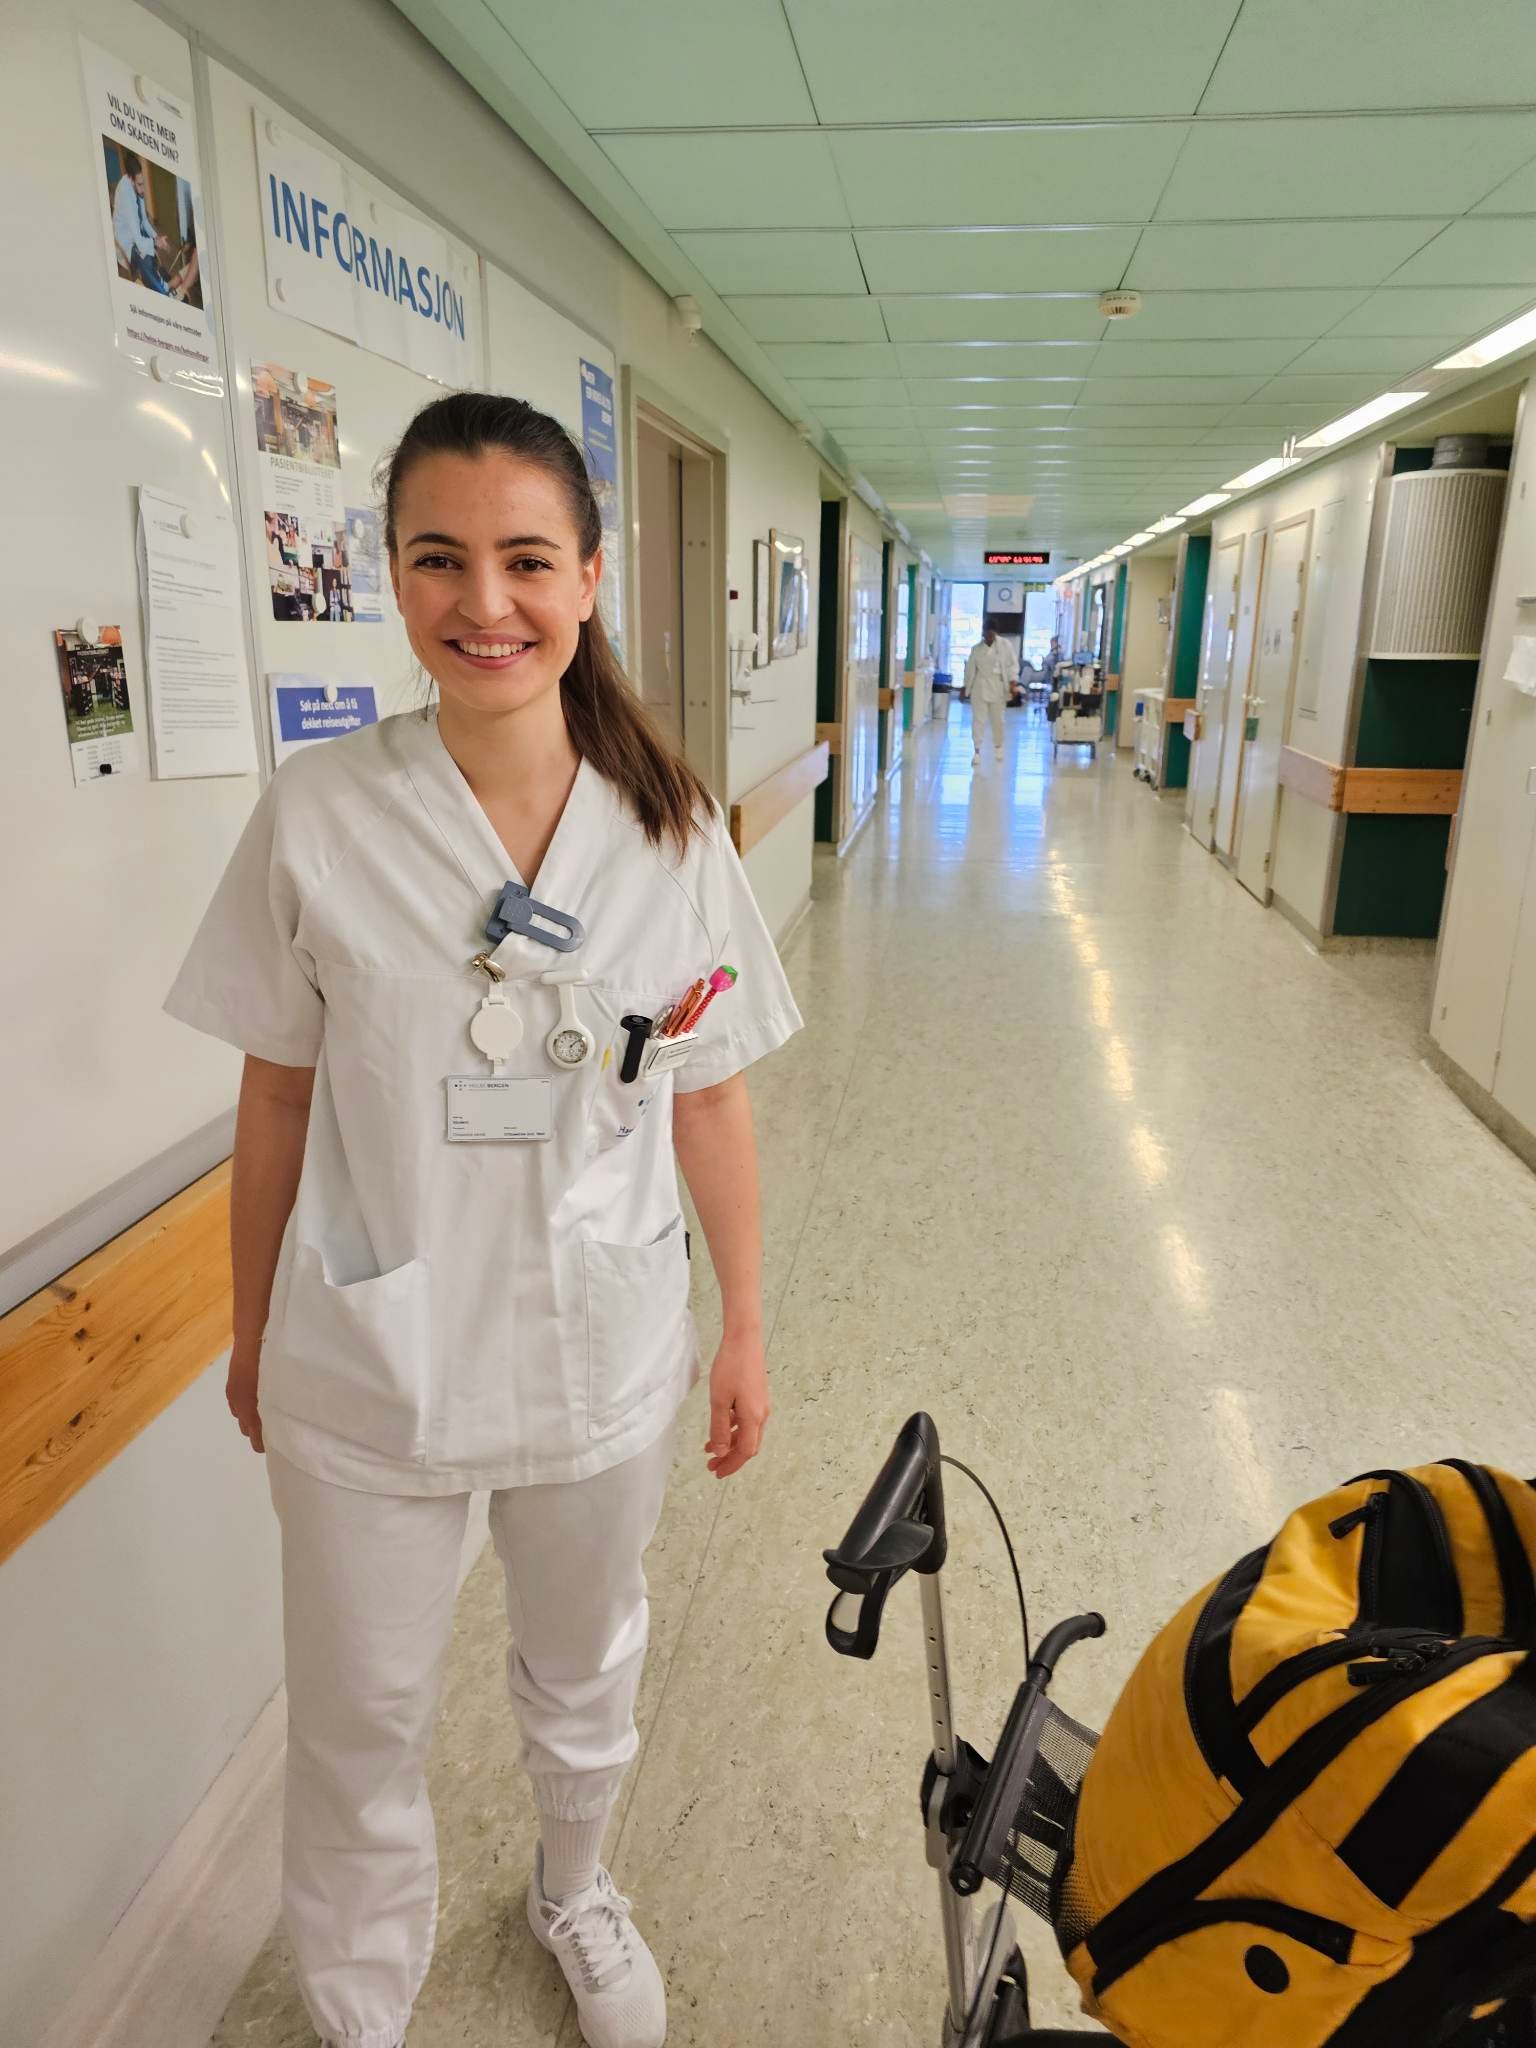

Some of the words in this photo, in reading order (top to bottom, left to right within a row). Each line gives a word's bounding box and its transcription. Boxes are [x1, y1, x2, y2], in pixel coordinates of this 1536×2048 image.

[107, 91, 122, 113] VIL
[122, 102, 136, 120] DU
[137, 110, 155, 133] VITE
[157, 123, 177, 145] MEIR
[110, 113, 126, 133] OM
[127, 123, 160, 153] SKADEN
[161, 143, 179, 163] DIN?
[269, 173, 465, 341] INFORMASJON
[300, 699, 312, 712] Søk
[312, 698, 321, 713] på
[334, 701, 345, 710] om
